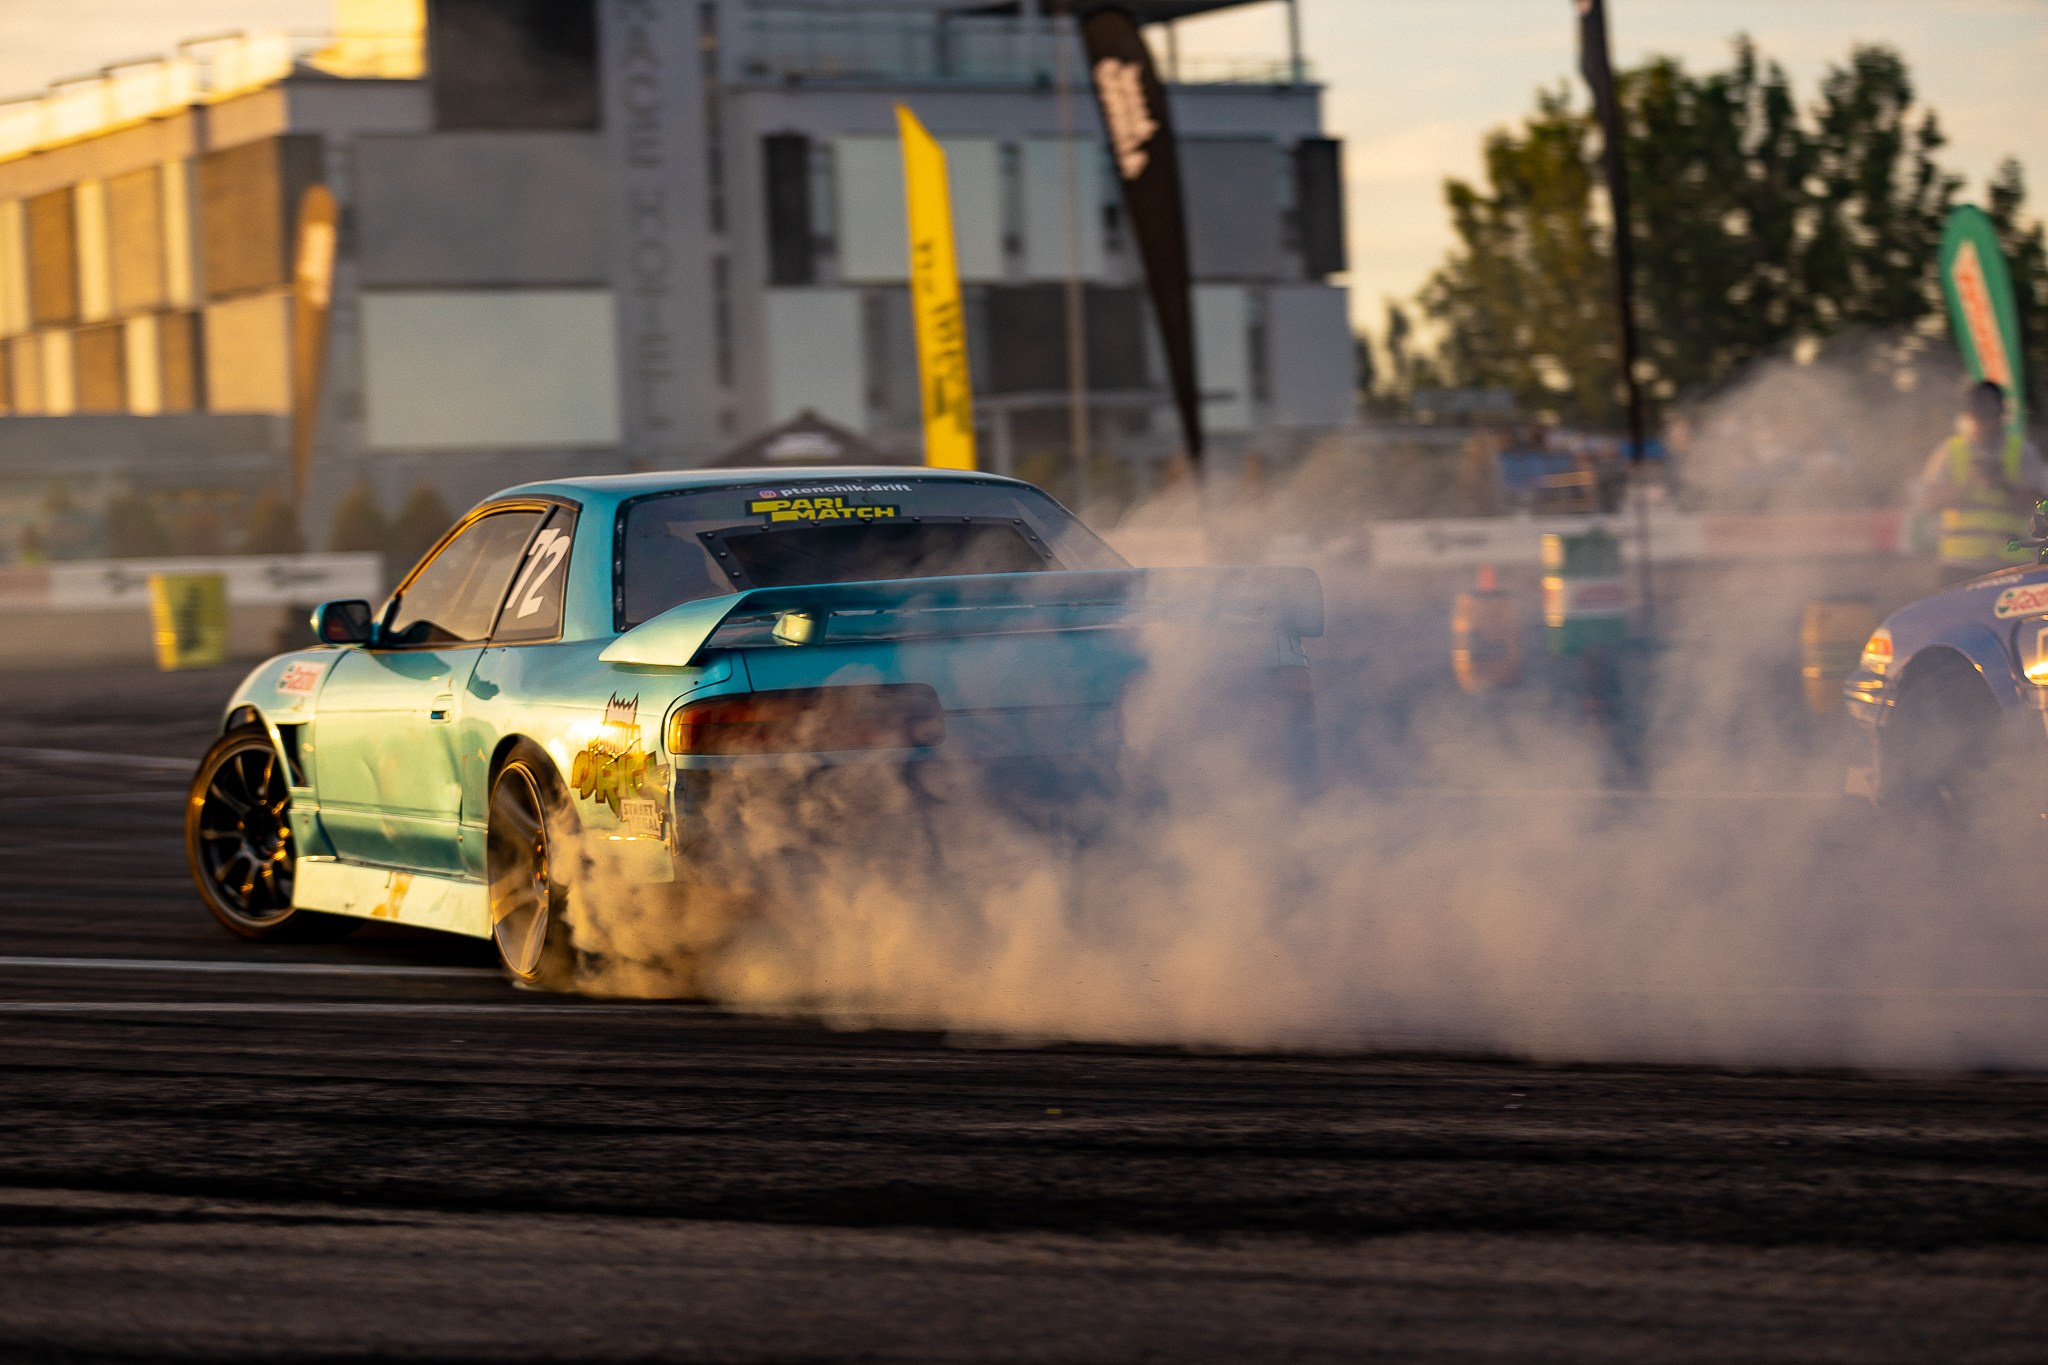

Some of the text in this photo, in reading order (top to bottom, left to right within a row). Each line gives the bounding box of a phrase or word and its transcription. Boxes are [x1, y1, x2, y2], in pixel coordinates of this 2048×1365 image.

[627, 189, 674, 432] HOTEL
[780, 484, 912, 497] ptenchik.drift
[752, 498, 843, 512] PARI
[772, 507, 894, 521] MATCH
[505, 528, 571, 619] 72
[623, 803, 653, 816] STREET
